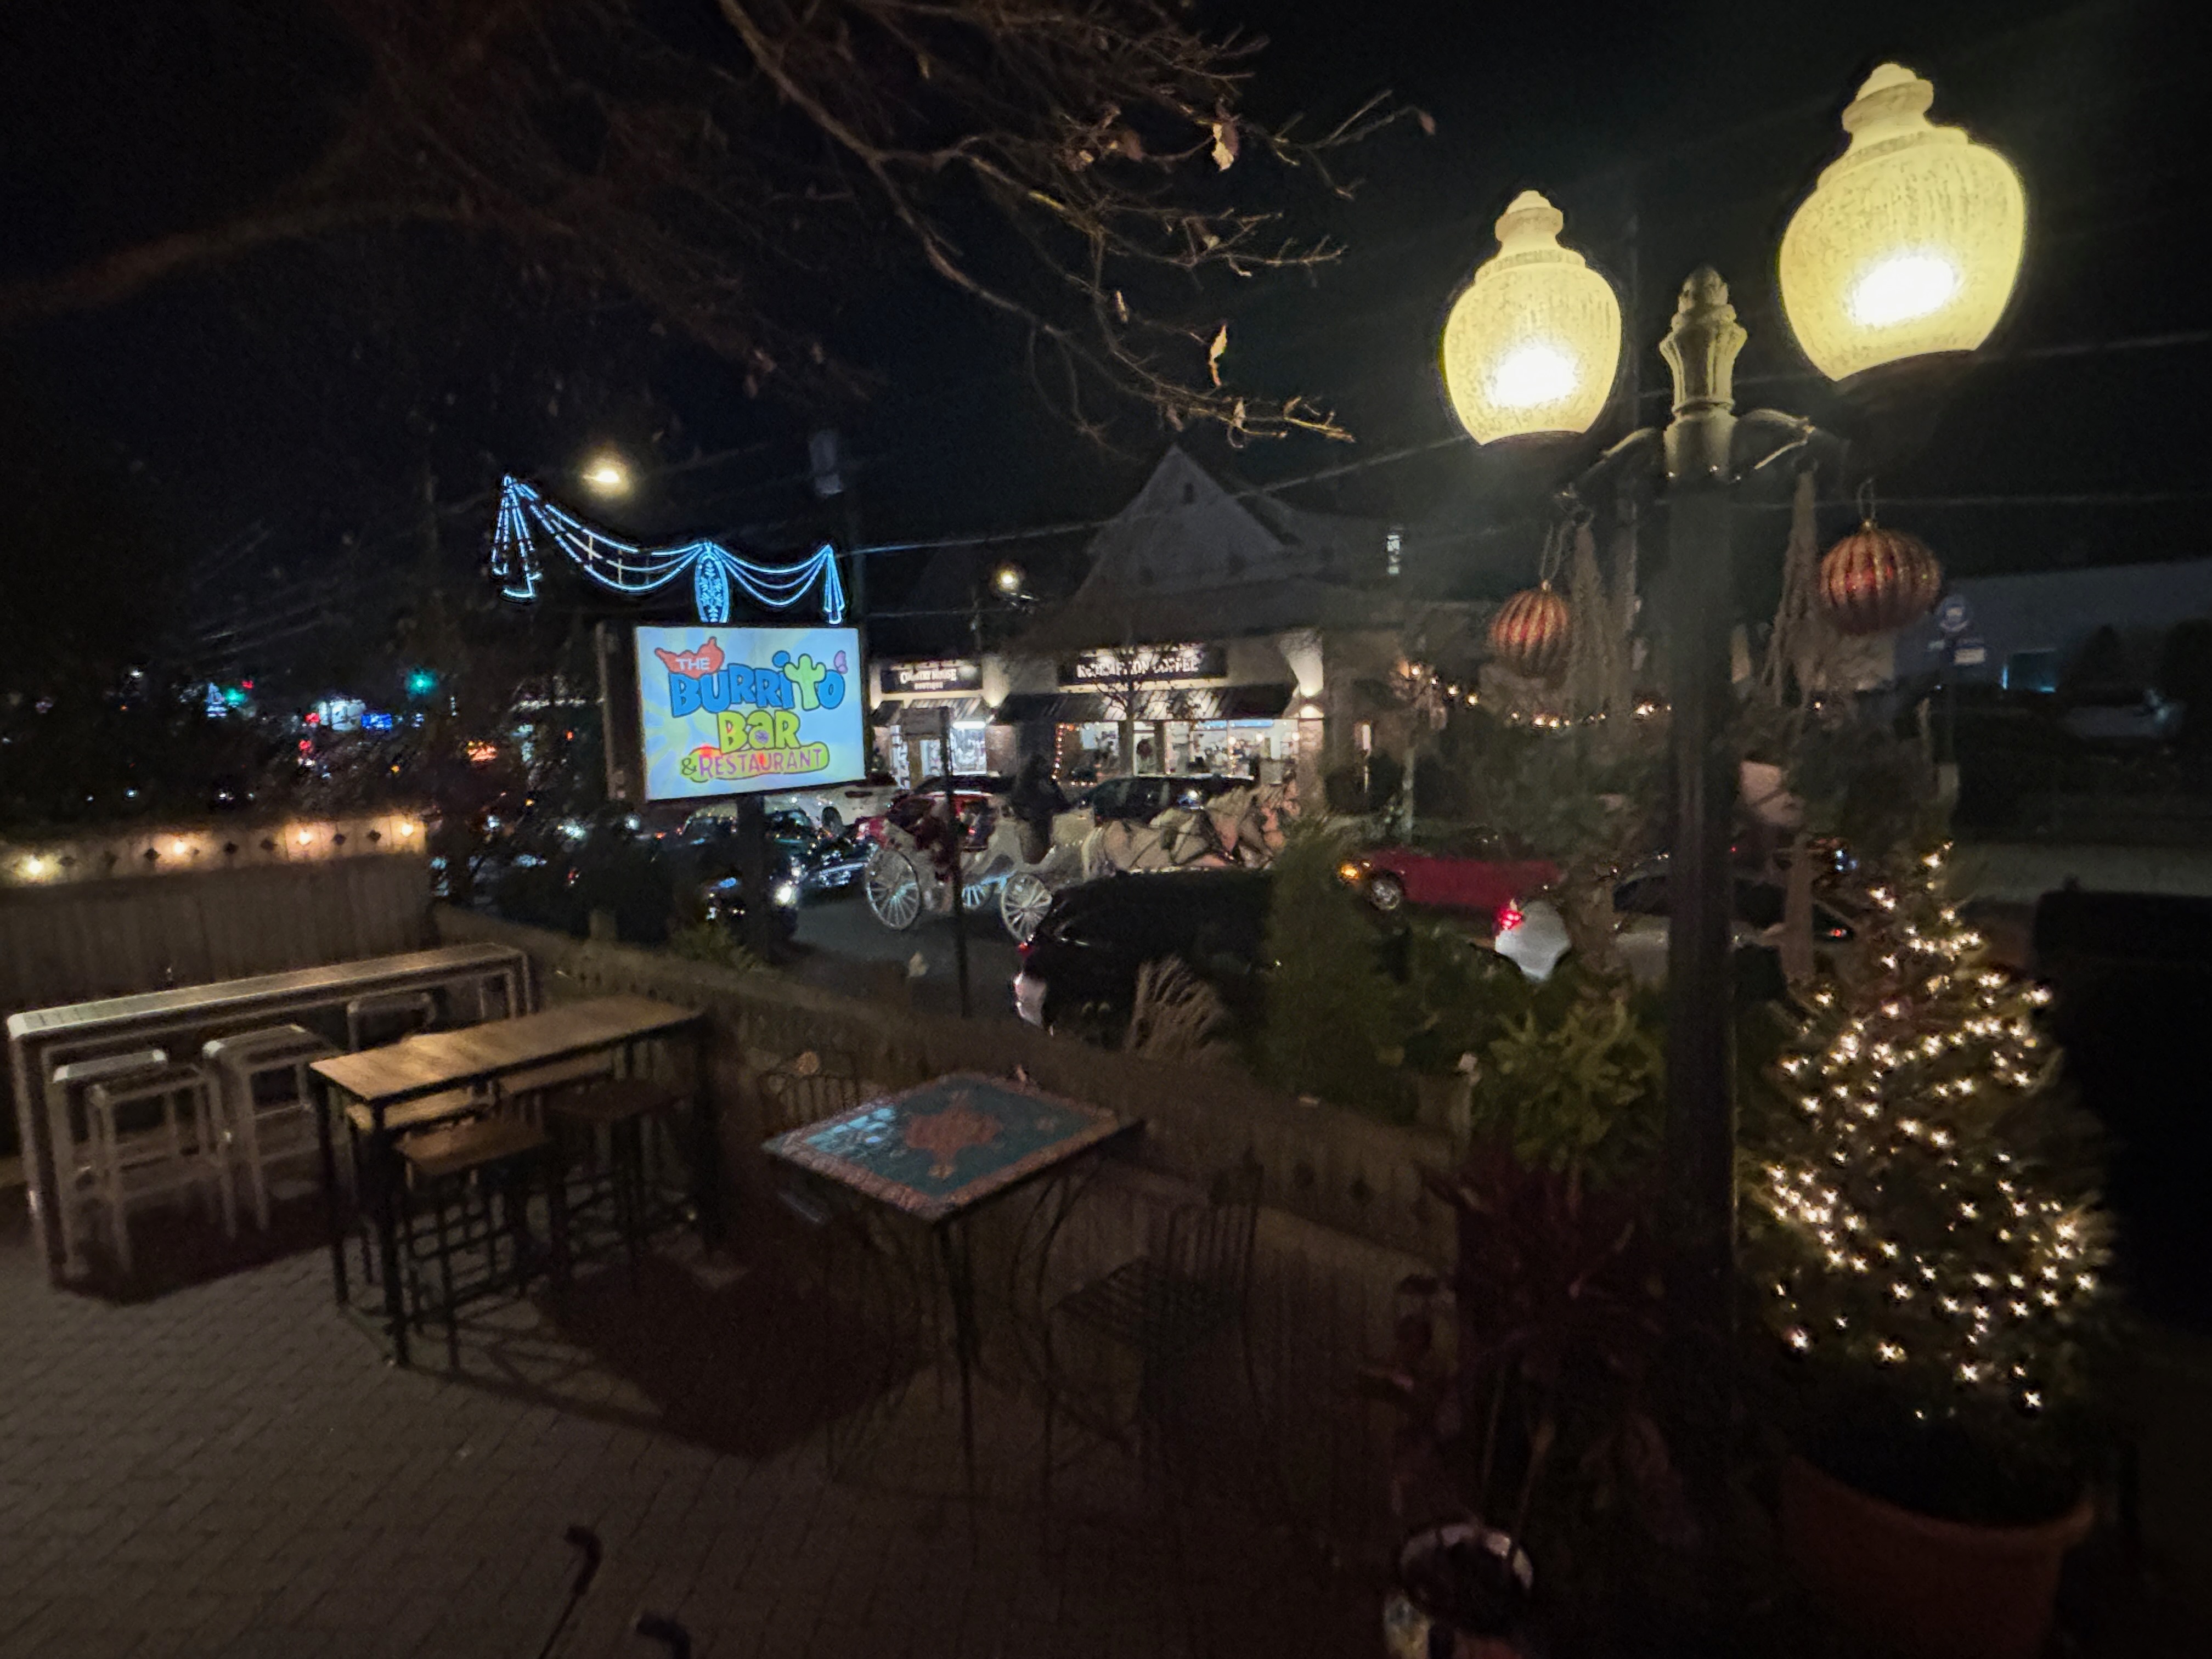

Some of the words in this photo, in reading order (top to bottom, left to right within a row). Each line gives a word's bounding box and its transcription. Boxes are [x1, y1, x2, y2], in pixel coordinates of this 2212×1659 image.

[676, 657, 710, 670] THE
[681, 758, 698, 776] &
[698, 748, 822, 778] RESTAURANT
